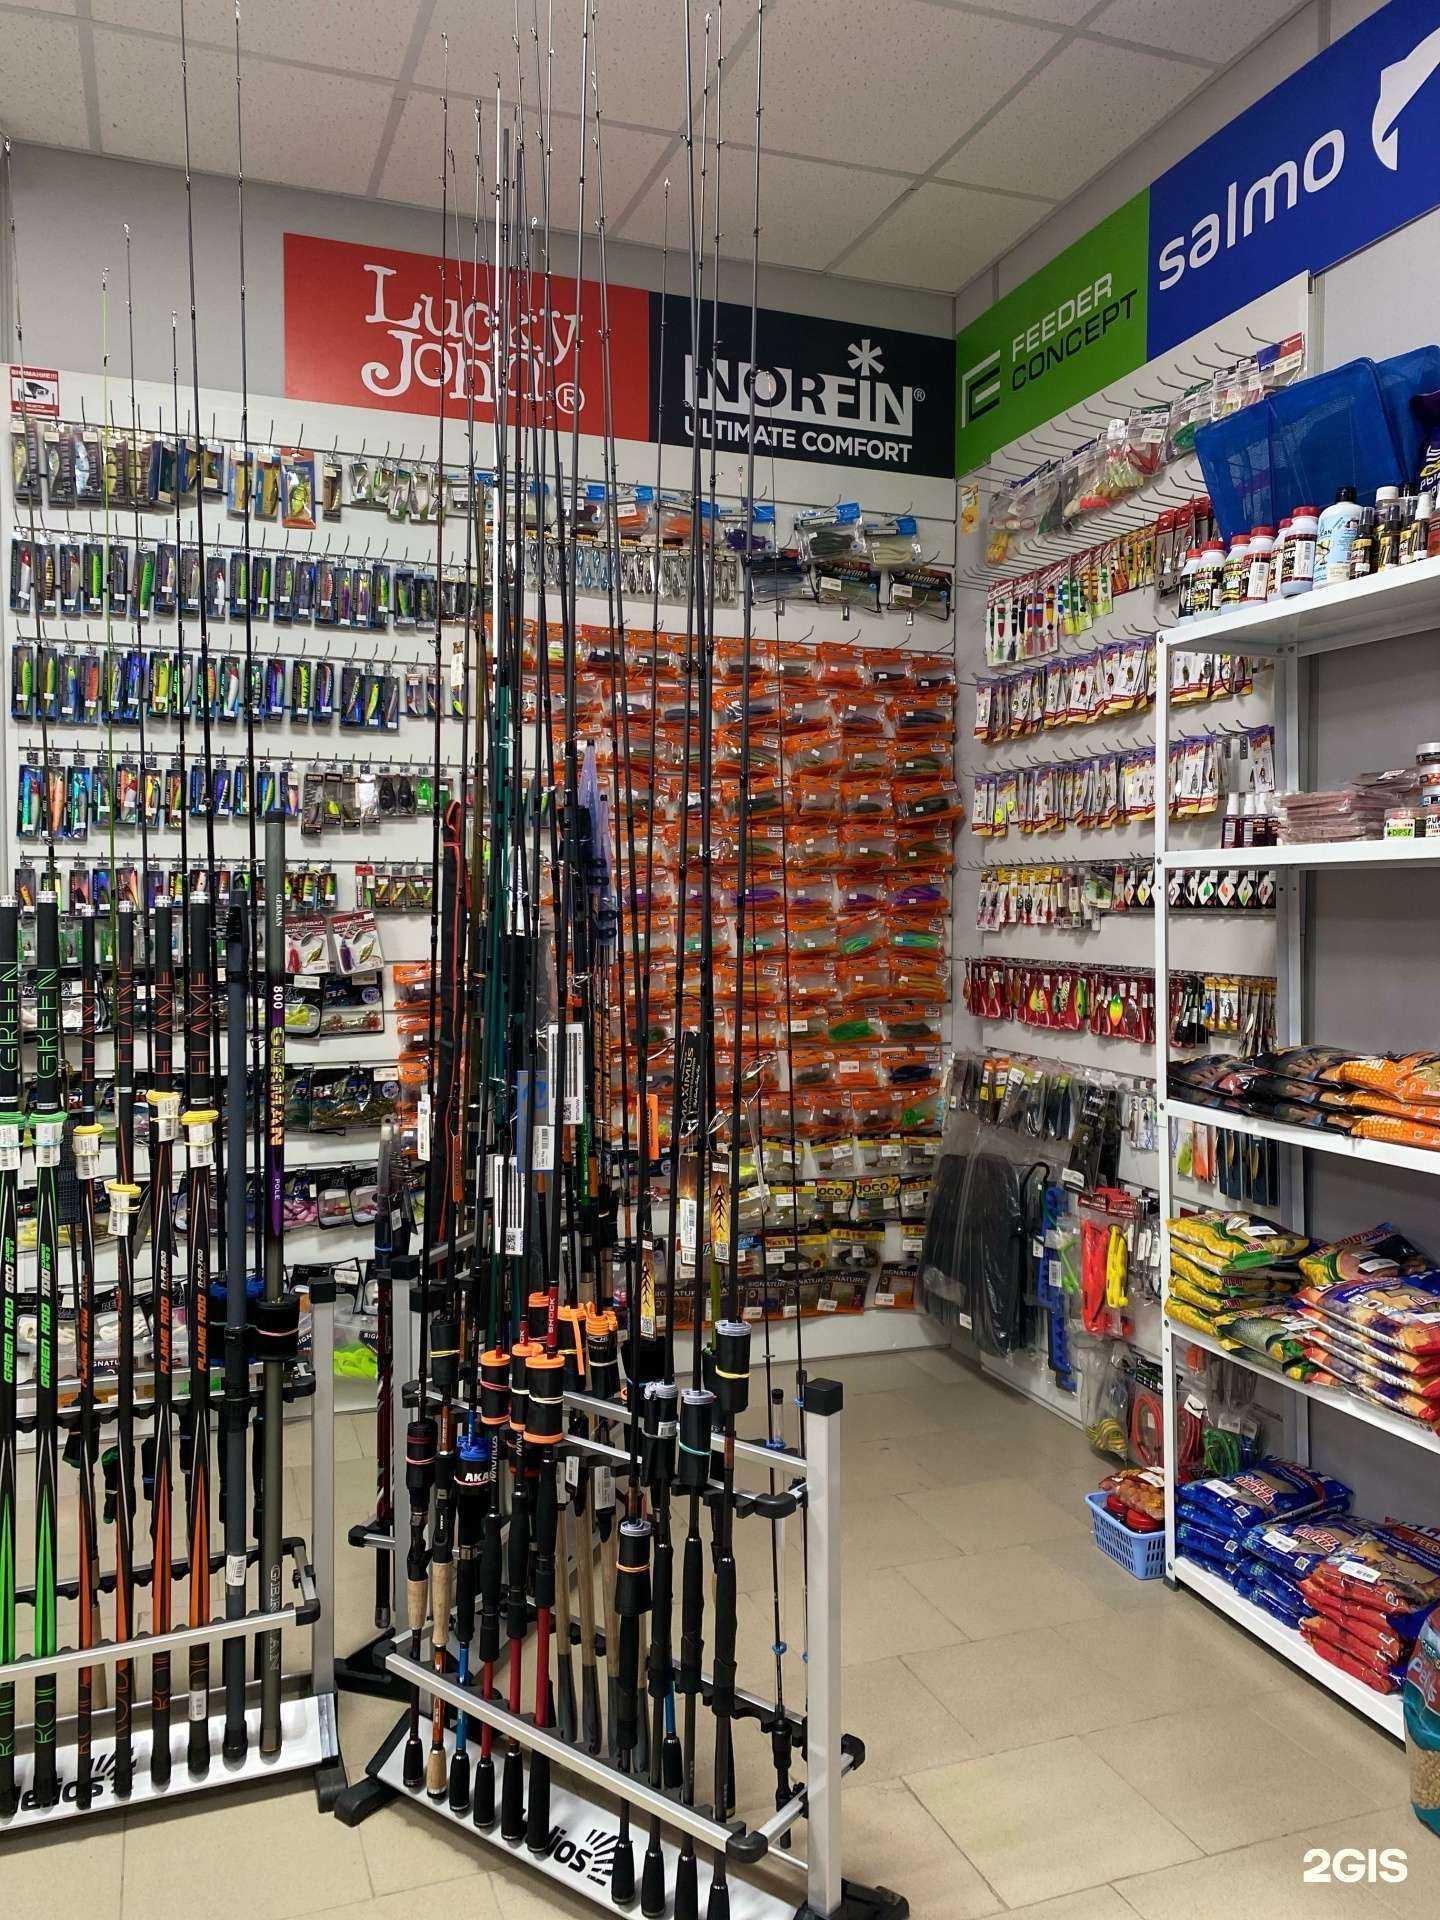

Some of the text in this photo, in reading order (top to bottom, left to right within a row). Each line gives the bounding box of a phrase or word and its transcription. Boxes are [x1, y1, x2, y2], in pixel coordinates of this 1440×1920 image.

[1159, 129, 1345, 291] salmo
[363, 264, 583, 367] Lucky
[1012, 272, 1113, 362] FEEDER
[1012, 288, 1138, 391] CONCEPT
[361, 330, 549, 403] John
[686, 356, 912, 436] NORFIN
[684, 415, 913, 463] ULTIMATE COMFORT
[275, 893, 284, 928] GERMAN
[273, 985, 284, 1009] 800
[4, 1297, 14, 1330] ROD
[41, 1267, 51, 1390] GREEN ROD 700
[160, 1296, 170, 1327] ROD
[197, 1293, 207, 1324] ROD
[548, 1298, 556, 1334] SHOCK
[3, 1332, 14, 1384] GREEN
[160, 1328, 170, 1376] FLAME
[197, 1325, 207, 1373] FLAME
